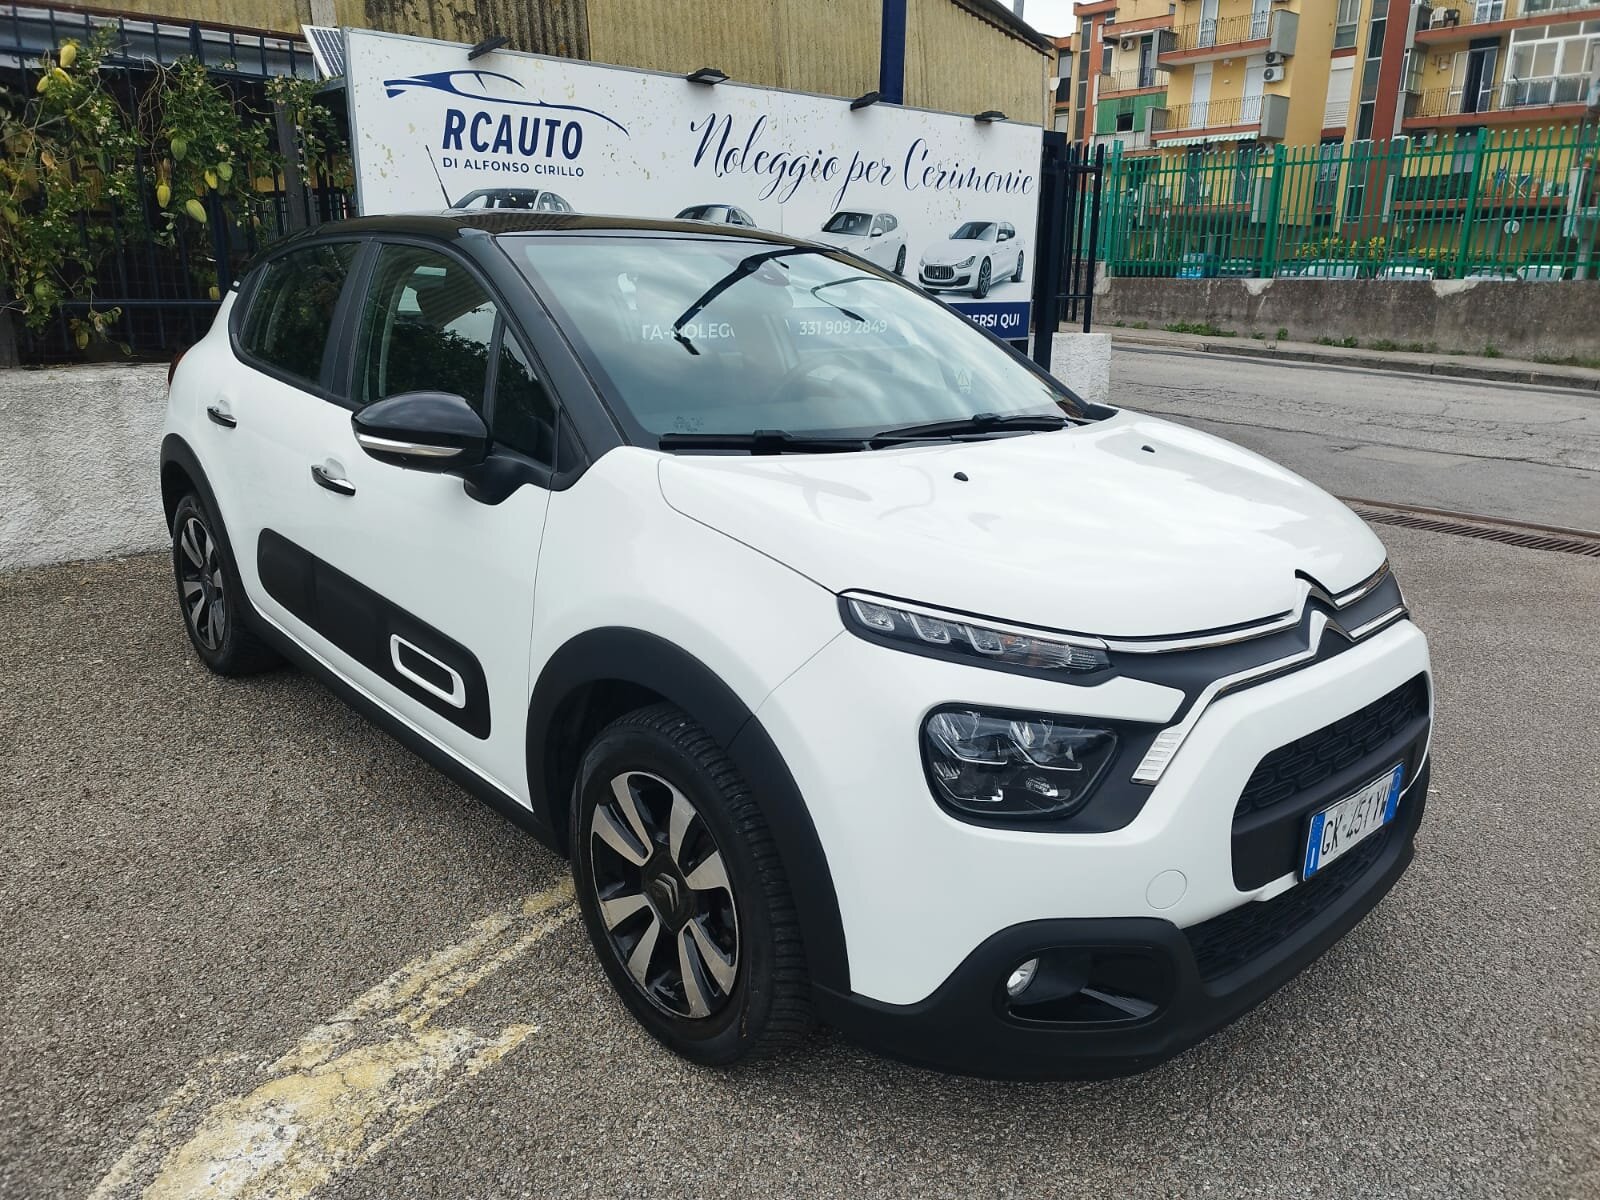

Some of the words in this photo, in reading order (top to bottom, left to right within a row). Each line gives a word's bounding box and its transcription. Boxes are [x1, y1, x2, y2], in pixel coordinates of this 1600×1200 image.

[442, 108, 583, 160] RCAUTO
[443, 157, 458, 169] DI
[464, 159, 530, 173] ALFONSO
[534, 164, 585, 178] CIRILLO
[690, 112, 841, 204] Noleggio
[829, 150, 897, 215] per
[903, 137, 1035, 196] Cerimonie
[799, 320, 821, 336] 331
[825, 320, 852, 335] 909
[854, 318, 888, 334] 2849
[1000, 313, 1020, 329] QUI
[1321, 813, 1343, 856] GK
